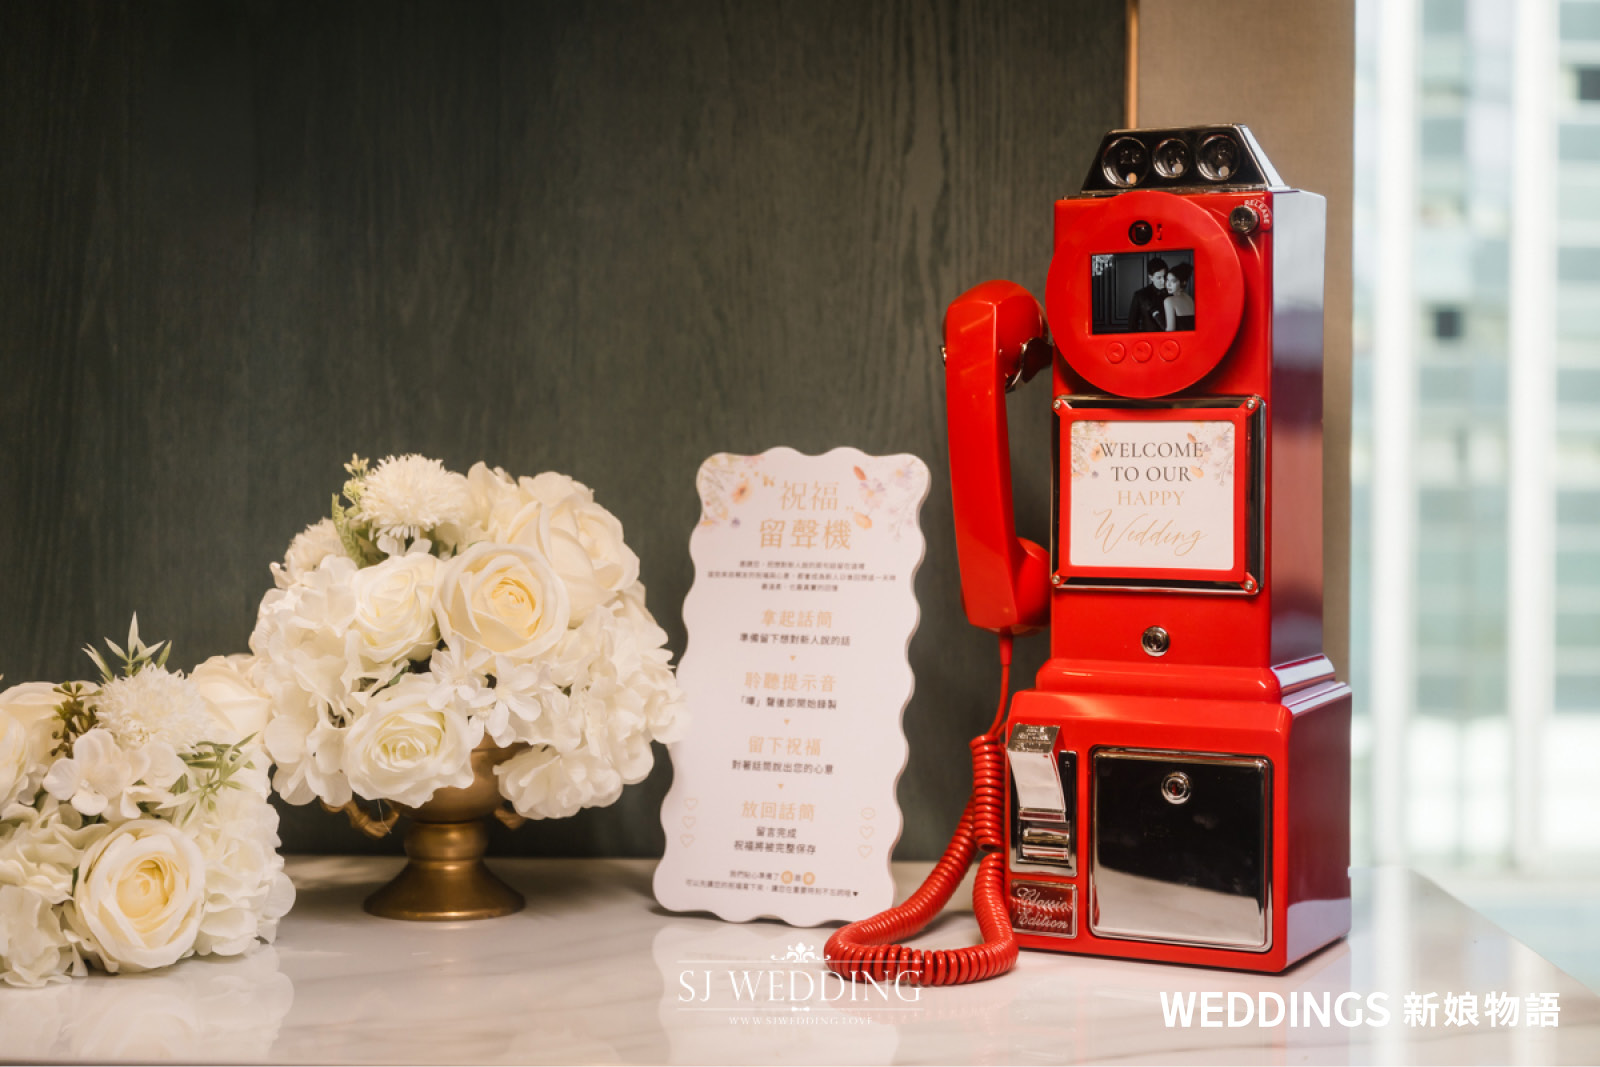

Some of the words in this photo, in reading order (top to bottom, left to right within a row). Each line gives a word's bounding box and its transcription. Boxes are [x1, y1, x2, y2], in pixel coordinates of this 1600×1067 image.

[1243, 198, 1271, 225] RELEASE
[1099, 442, 1204, 458] WELCOME
[1110, 466, 1140, 481] TO
[1146, 466, 1192, 482] OUR
[778, 480, 840, 511] 祝福
[1117, 490, 1185, 506] HAPPY
[759, 518, 852, 550] 留聲機
[1092, 508, 1208, 557] Wedding
[761, 608, 833, 629] 拿起話筒
[743, 672, 837, 693] 聆聽提示音
[747, 736, 822, 757] 留下祝福
[741, 800, 816, 822] 放回話筒
[755, 826, 797, 839] 留言完成
[733, 840, 817, 855] 祝福將被完整保存
[1016, 888, 1069, 909] Classic
[1018, 909, 1069, 930] Edition
